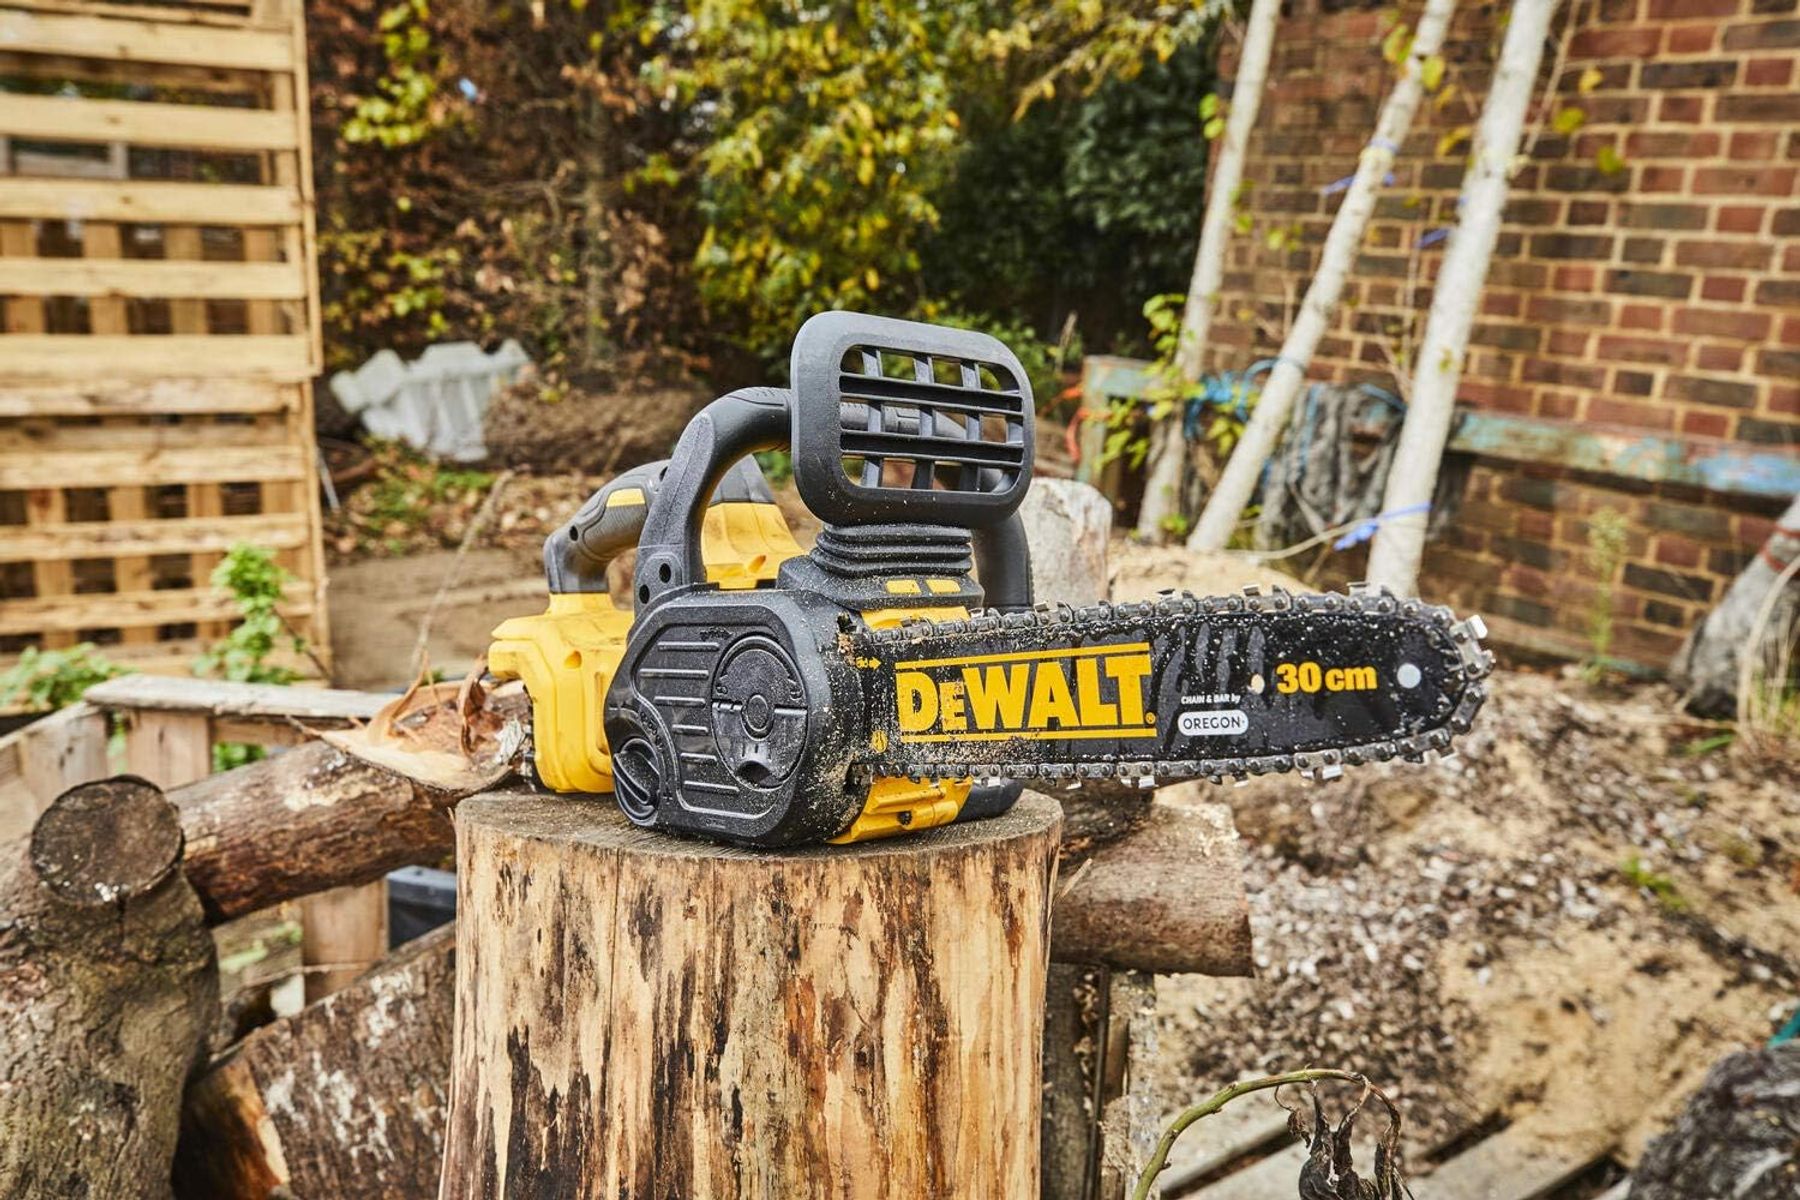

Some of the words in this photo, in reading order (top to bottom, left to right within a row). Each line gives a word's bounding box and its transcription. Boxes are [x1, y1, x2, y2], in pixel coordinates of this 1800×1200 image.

[1276, 662, 1322, 694] 30
[1325, 665, 1378, 692] cm
[1181, 695, 1205, 705] CHAIN
[1206, 694, 1212, 704] &
[1214, 693, 1230, 703] BAR
[1183, 716, 1241, 730] OREGON
